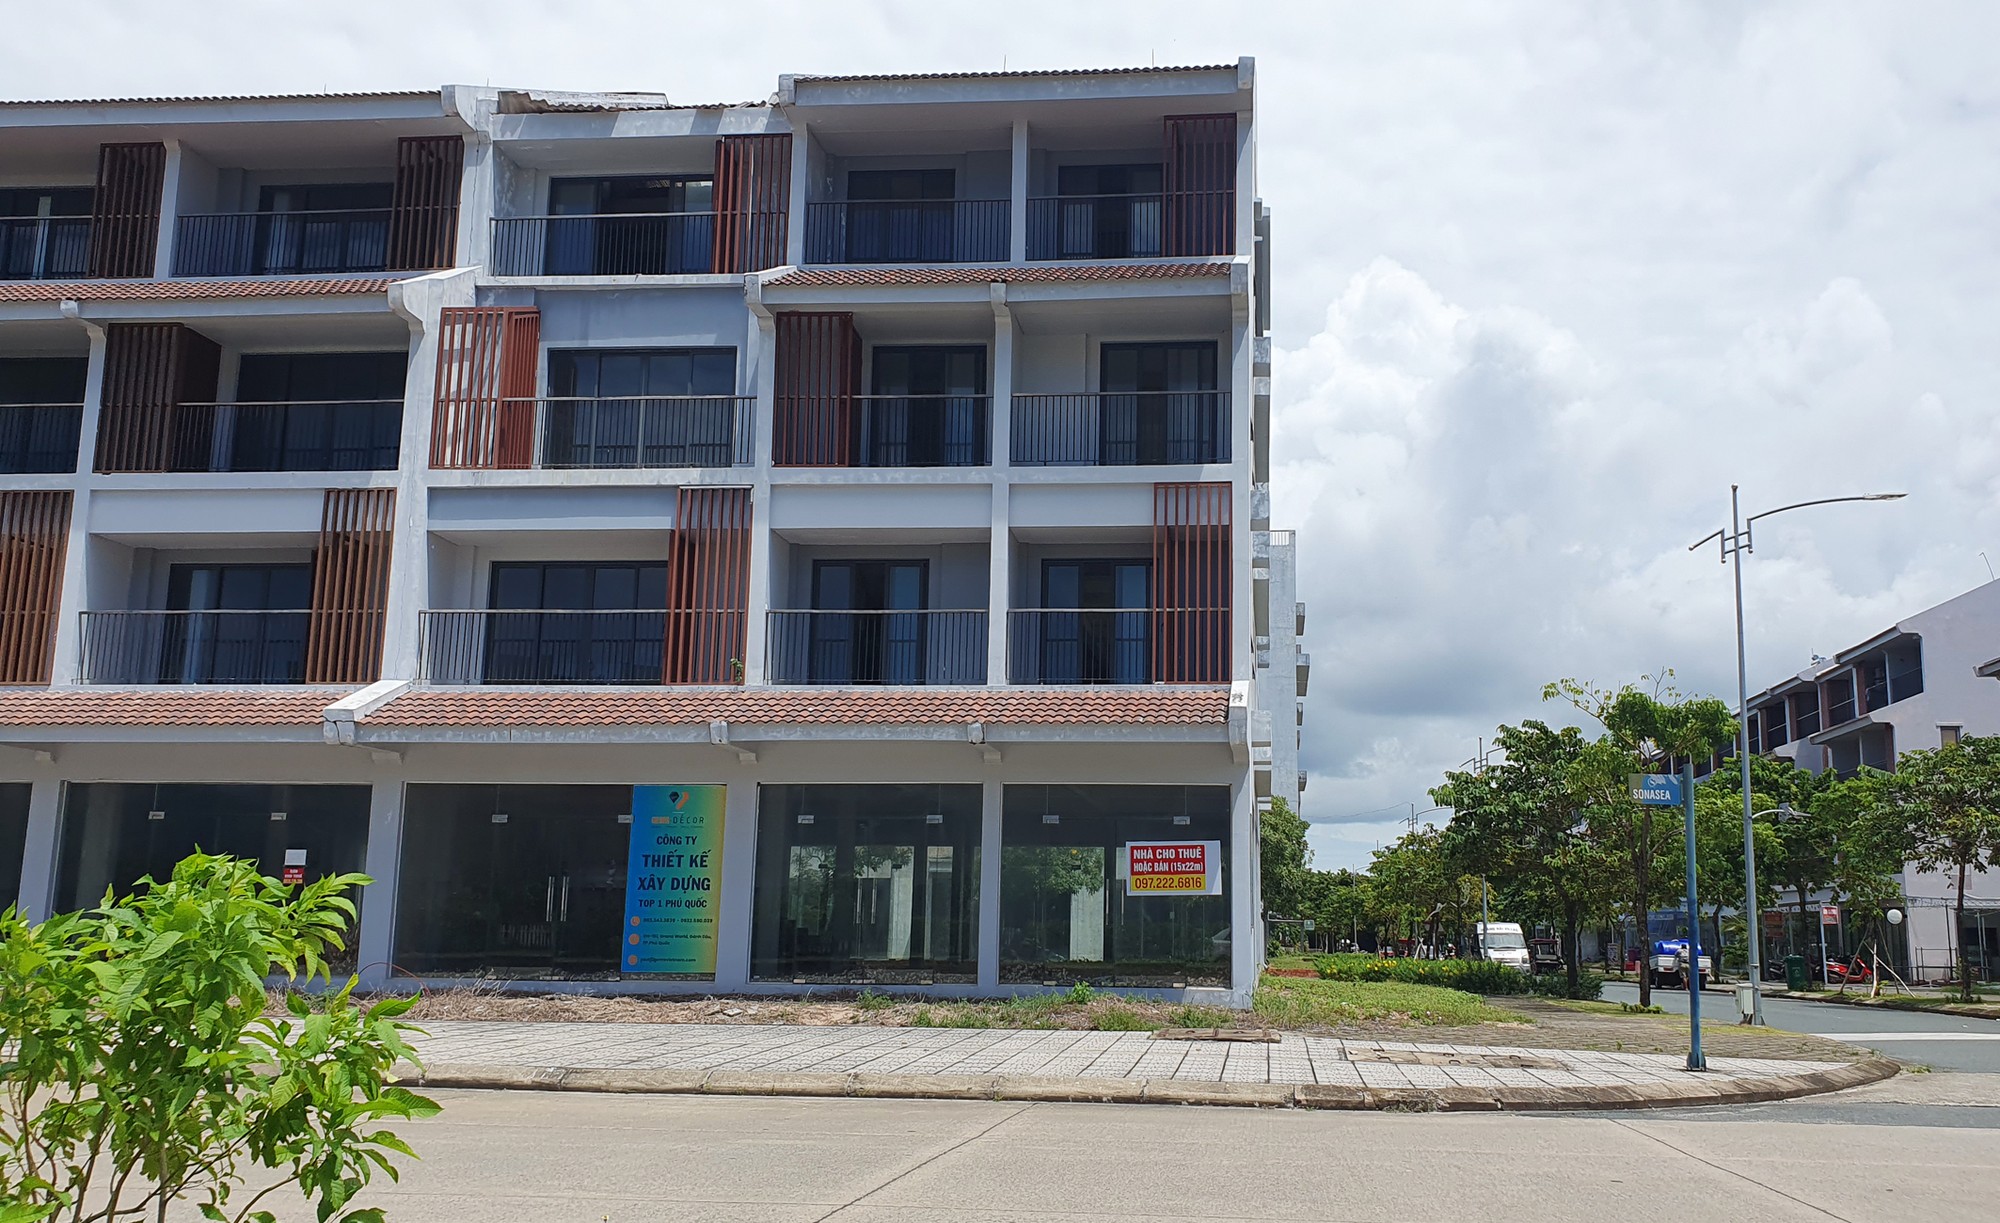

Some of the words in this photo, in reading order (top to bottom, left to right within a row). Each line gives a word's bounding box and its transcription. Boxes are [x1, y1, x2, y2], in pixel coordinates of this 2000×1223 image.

[1632, 788, 1671, 800] SONASEA
[656, 833, 682, 845] CÔNG
[685, 835, 697, 845] TY
[642, 849, 685, 868] THIẾT
[689, 849, 711, 868] KẾ
[1133, 847, 1153, 859] NHÀ
[1156, 848, 1175, 859] CHO
[1177, 846, 1202, 859] THUÊ
[1133, 860, 1153, 873] HOẶC
[1170, 861, 1203, 872] (15x22m)
[637, 873, 666, 891] XÂY
[670, 874, 711, 894] DỰNG
[1135, 877, 1202, 889] 097.222.6816
[638, 899, 655, 908] TOP
[658, 899, 662, 907] 1
[665, 897, 682, 908] PHÚ
[684, 896, 708, 909] QUỐC
